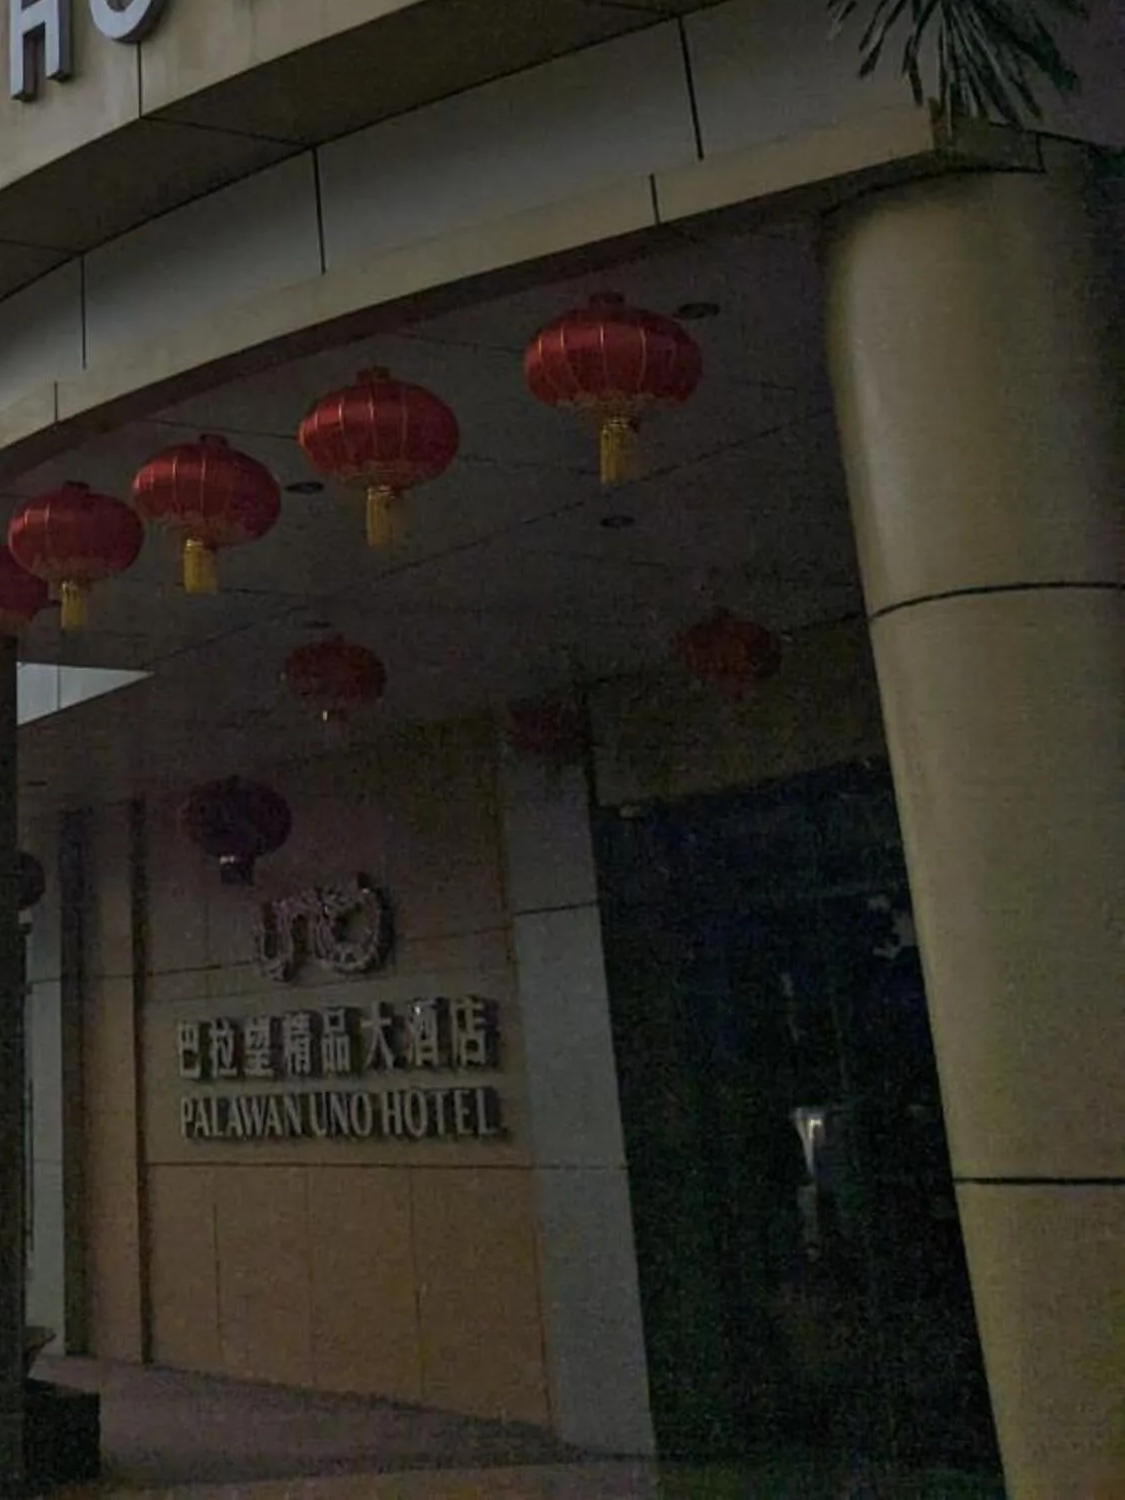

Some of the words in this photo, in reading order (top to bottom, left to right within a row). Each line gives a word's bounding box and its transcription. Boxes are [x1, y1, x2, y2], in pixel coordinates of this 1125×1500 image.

[177, 996, 490, 1081] 巴拉望精品大酒店
[180, 1092, 304, 1139] PALAWAN
[309, 1090, 373, 1138] UNO
[382, 1087, 498, 1137] HOTEL
